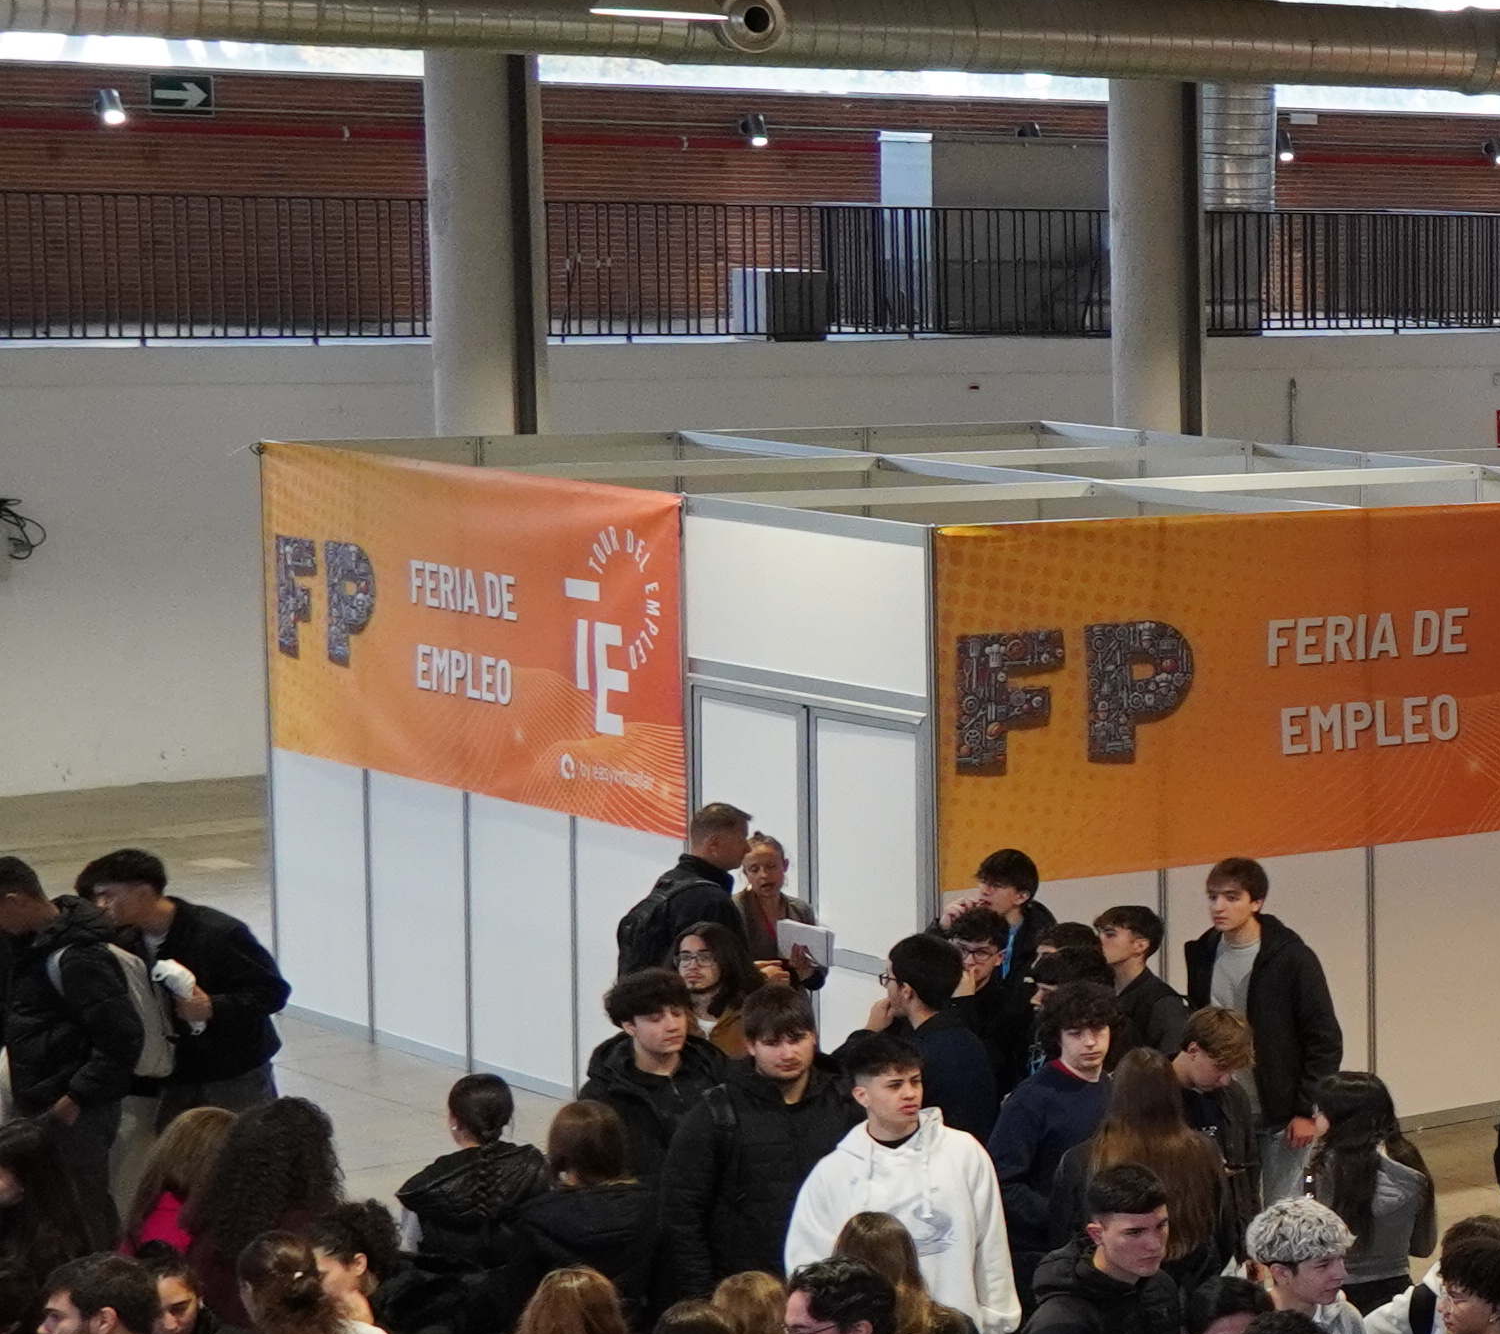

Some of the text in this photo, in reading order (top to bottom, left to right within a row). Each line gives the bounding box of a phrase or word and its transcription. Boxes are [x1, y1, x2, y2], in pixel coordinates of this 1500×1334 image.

[275, 536, 377, 668] FP
[409, 560, 518, 621] FERIA DE
[589, 526, 661, 669] TOUR DEL EMPLEO
[1268, 608, 1470, 667] FERIA DE
[417, 644, 513, 705] EMPLEO
[955, 620, 1195, 777] FP
[1281, 694, 1459, 756] EMPLEO
